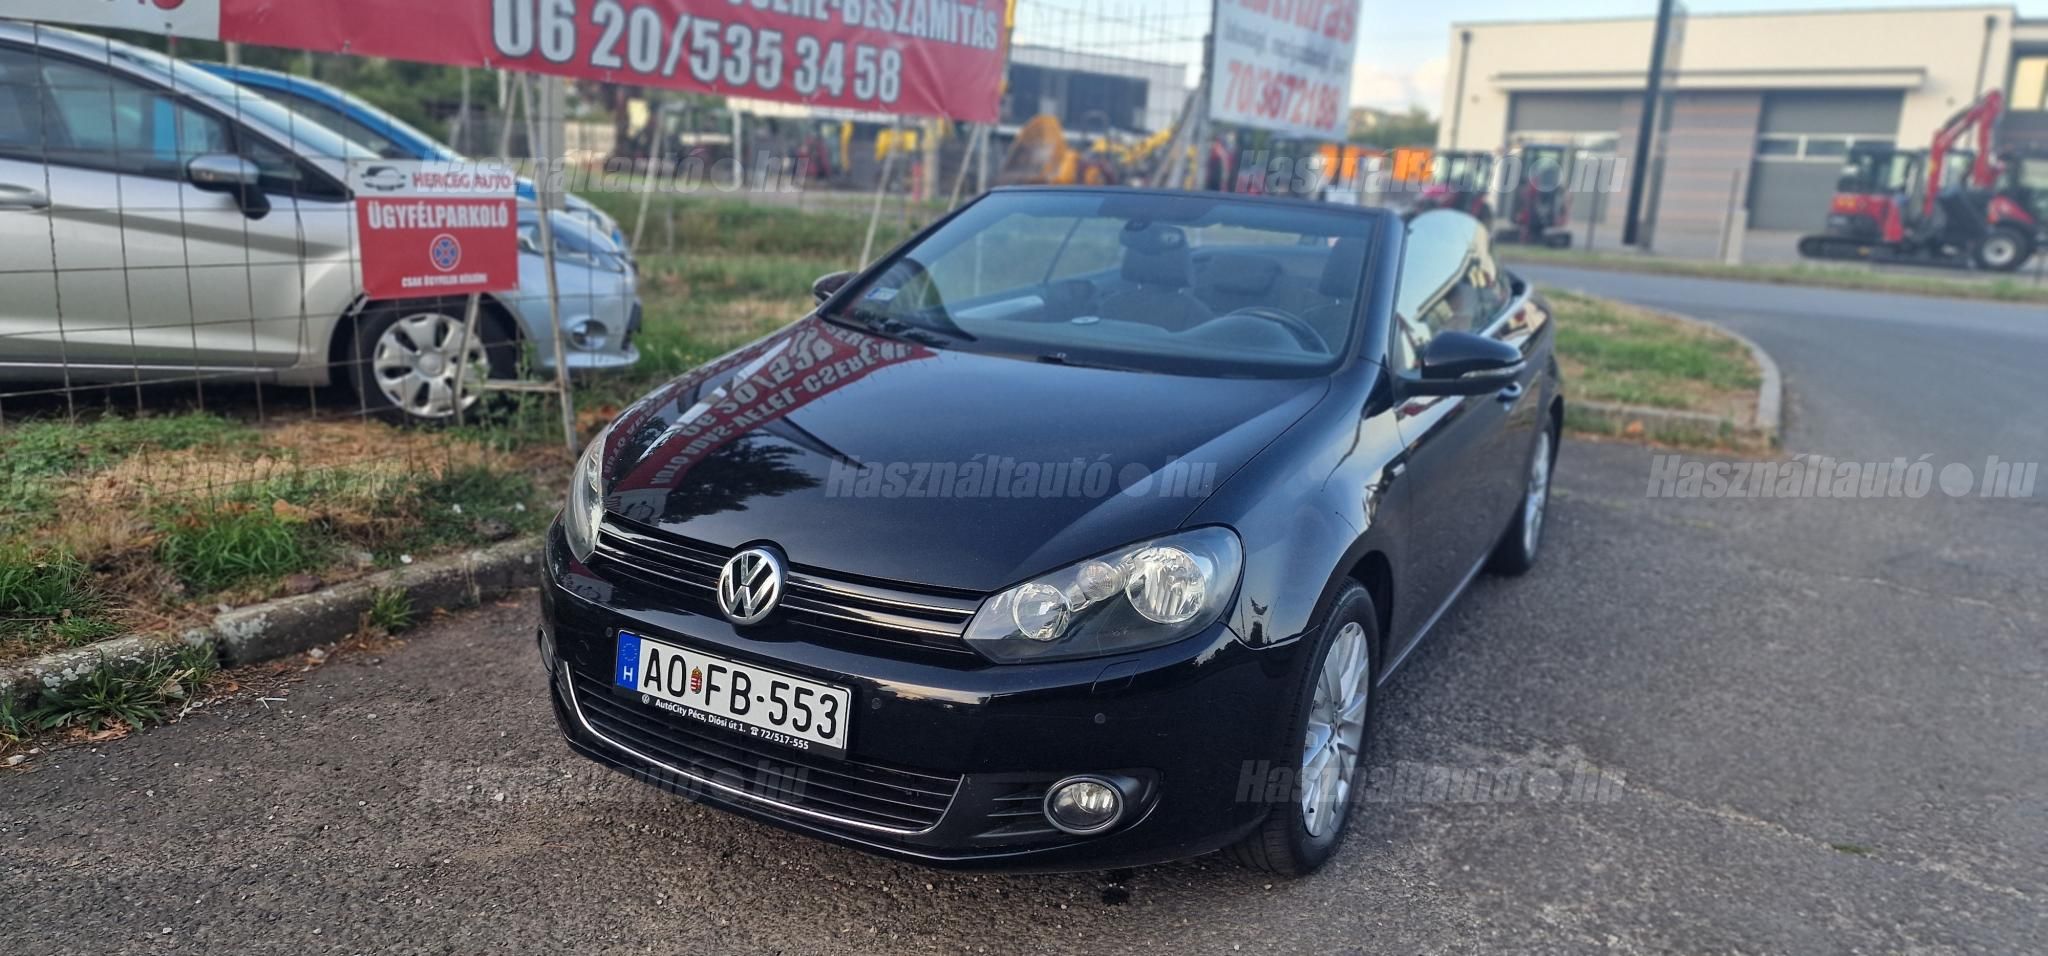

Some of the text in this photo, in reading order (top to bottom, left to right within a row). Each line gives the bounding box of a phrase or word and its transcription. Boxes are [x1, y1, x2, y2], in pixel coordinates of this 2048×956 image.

[493, 0, 902, 102] 06 20/535 34 58
[411, 172, 471, 188] HERCEG
[367, 200, 509, 229] ÜGYFÉLPARKOLÓ
[623, 666, 633, 682] H
[705, 663, 839, 740] FB-553
[655, 699, 809, 750] AutóCity Pécs, Diósi út 1. 72/517-555
